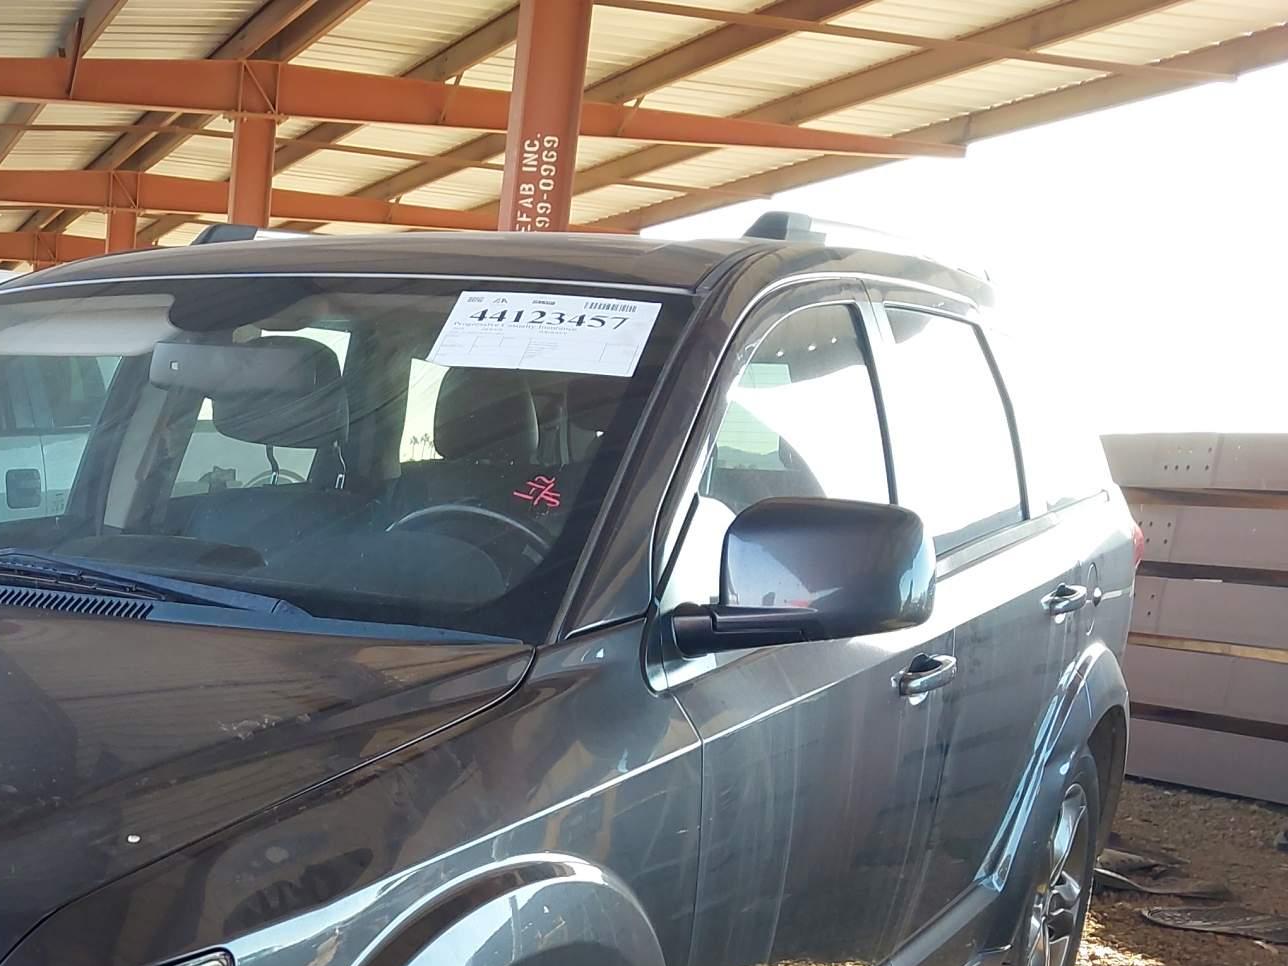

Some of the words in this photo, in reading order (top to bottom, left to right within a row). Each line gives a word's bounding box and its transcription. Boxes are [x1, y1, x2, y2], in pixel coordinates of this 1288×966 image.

[522, 133, 541, 172] INC.
[535, 135, 559, 232] 99-0969
[469, 308, 631, 330] 44123457
